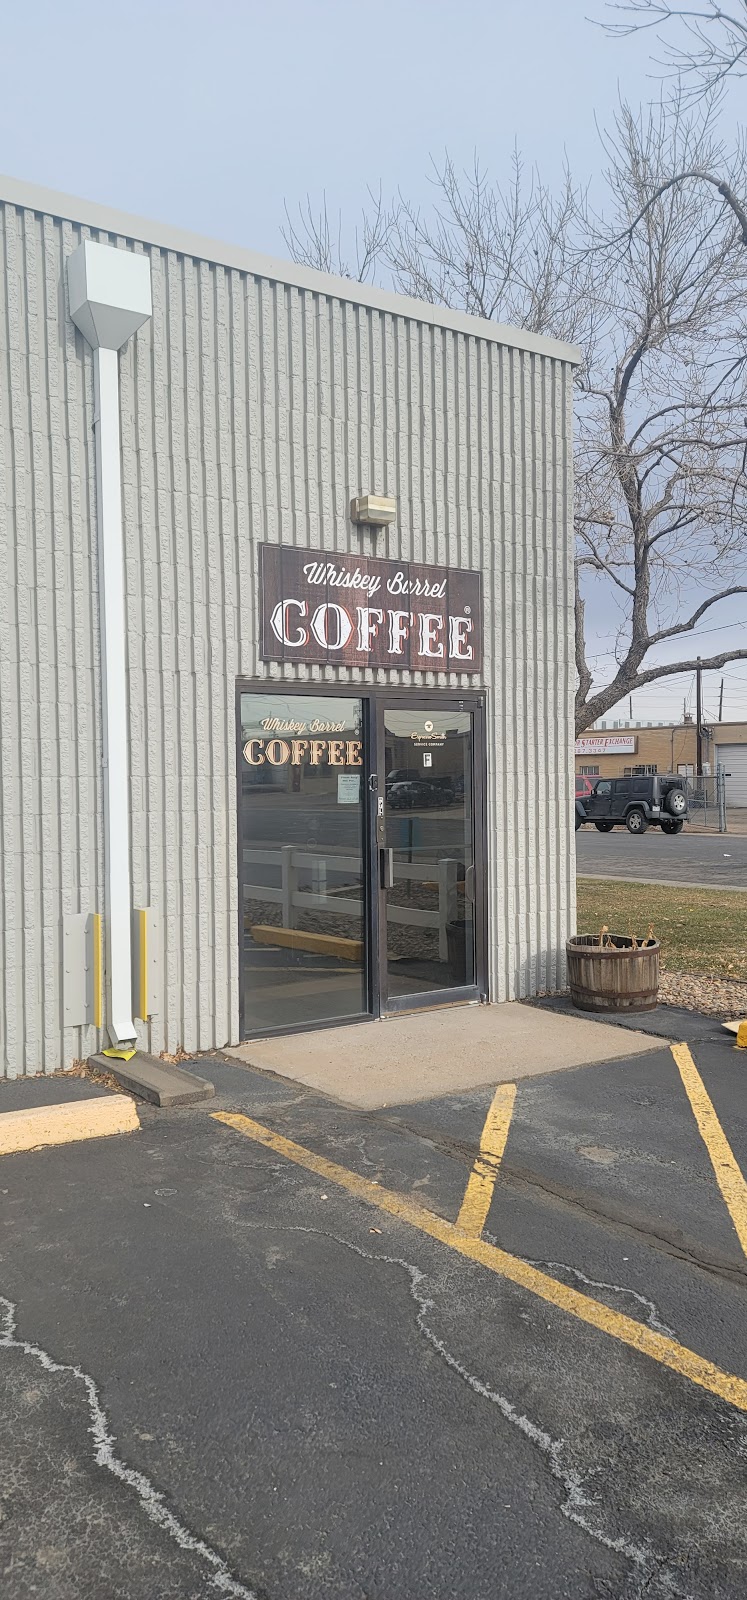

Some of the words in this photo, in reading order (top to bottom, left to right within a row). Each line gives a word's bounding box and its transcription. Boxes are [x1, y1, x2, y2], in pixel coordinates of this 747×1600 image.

[302, 561, 382, 598] Whiskey
[386, 571, 447, 599] Barrel
[269, 598, 475, 660] COFFEE
[261, 717, 307, 735] Whiskey
[309, 718, 346, 732] Barrel
[242, 738, 363, 766] COFFEE
